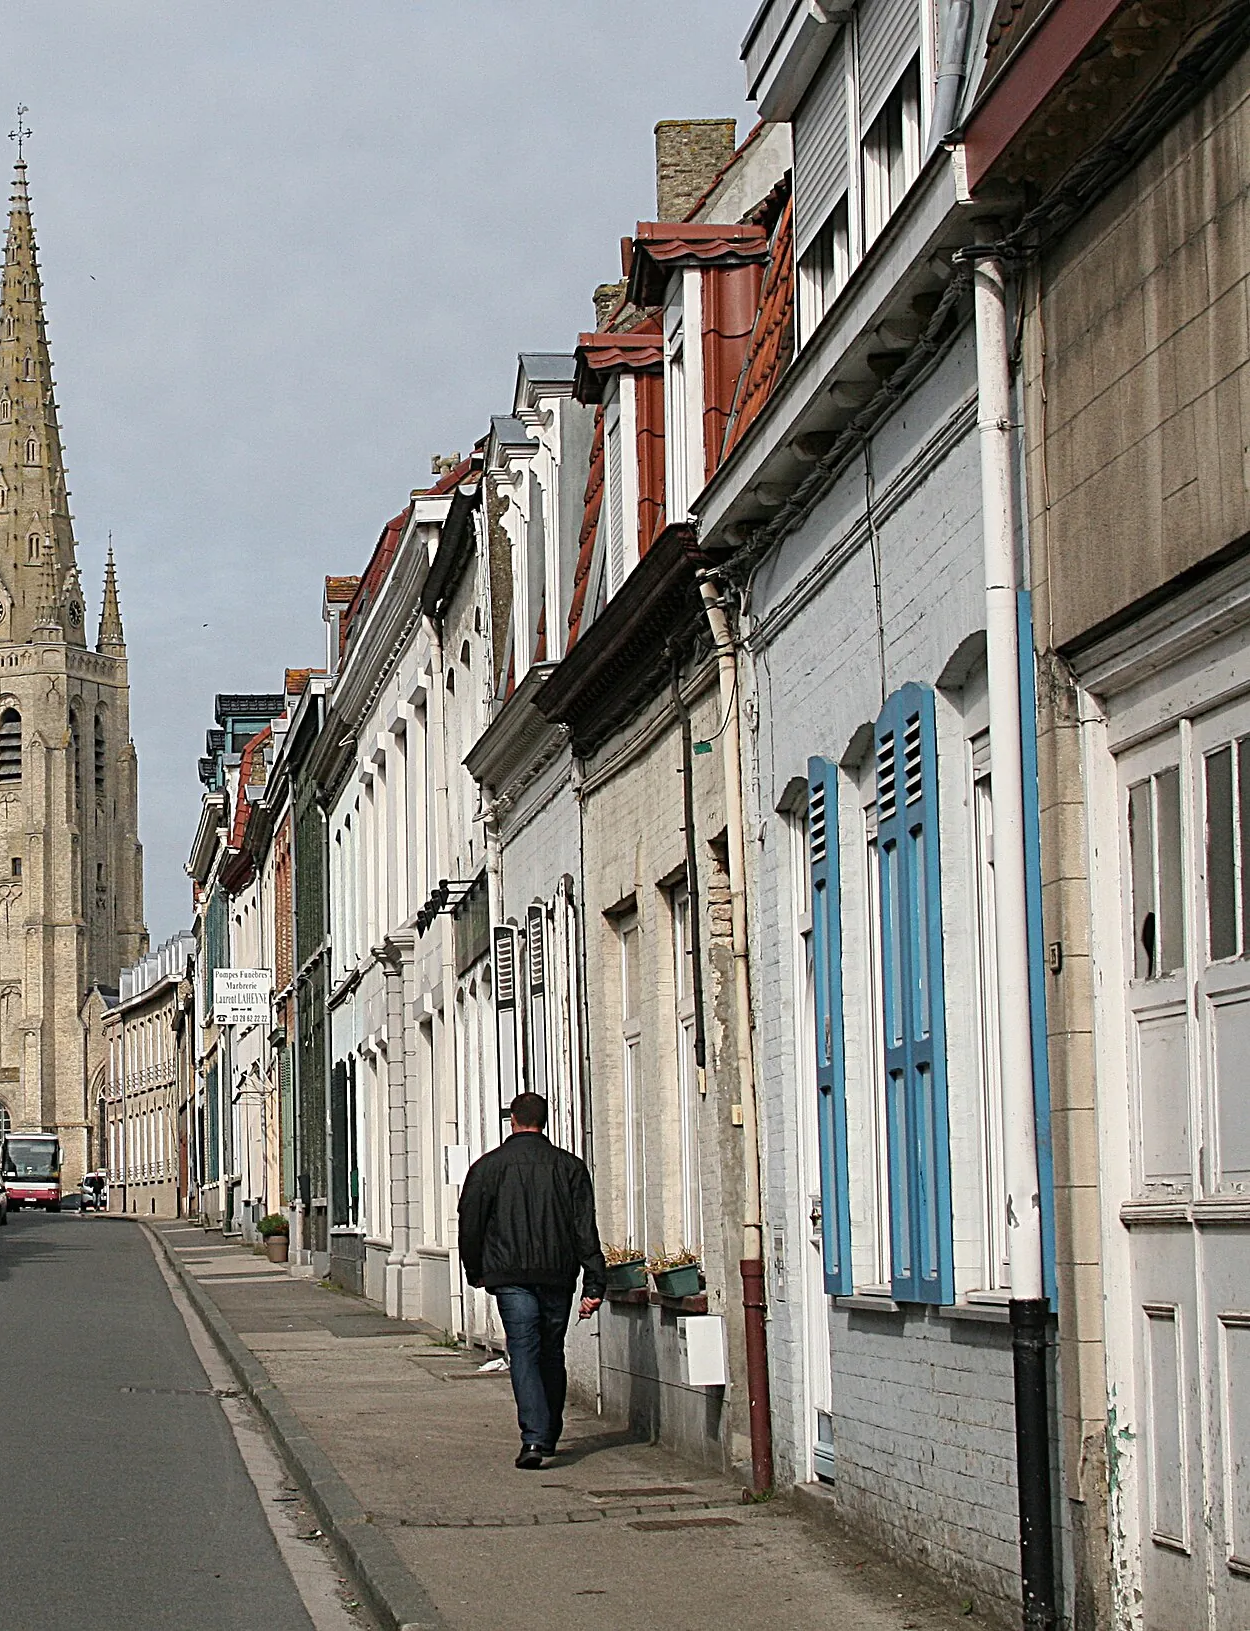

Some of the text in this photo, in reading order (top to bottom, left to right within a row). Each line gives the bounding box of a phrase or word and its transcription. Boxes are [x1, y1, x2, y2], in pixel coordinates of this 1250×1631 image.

[215, 971, 267, 980] Pompes Funèbres
[226, 981, 257, 990] Marbrerie
[215, 993, 267, 1004] Laurent LAHEYNE
